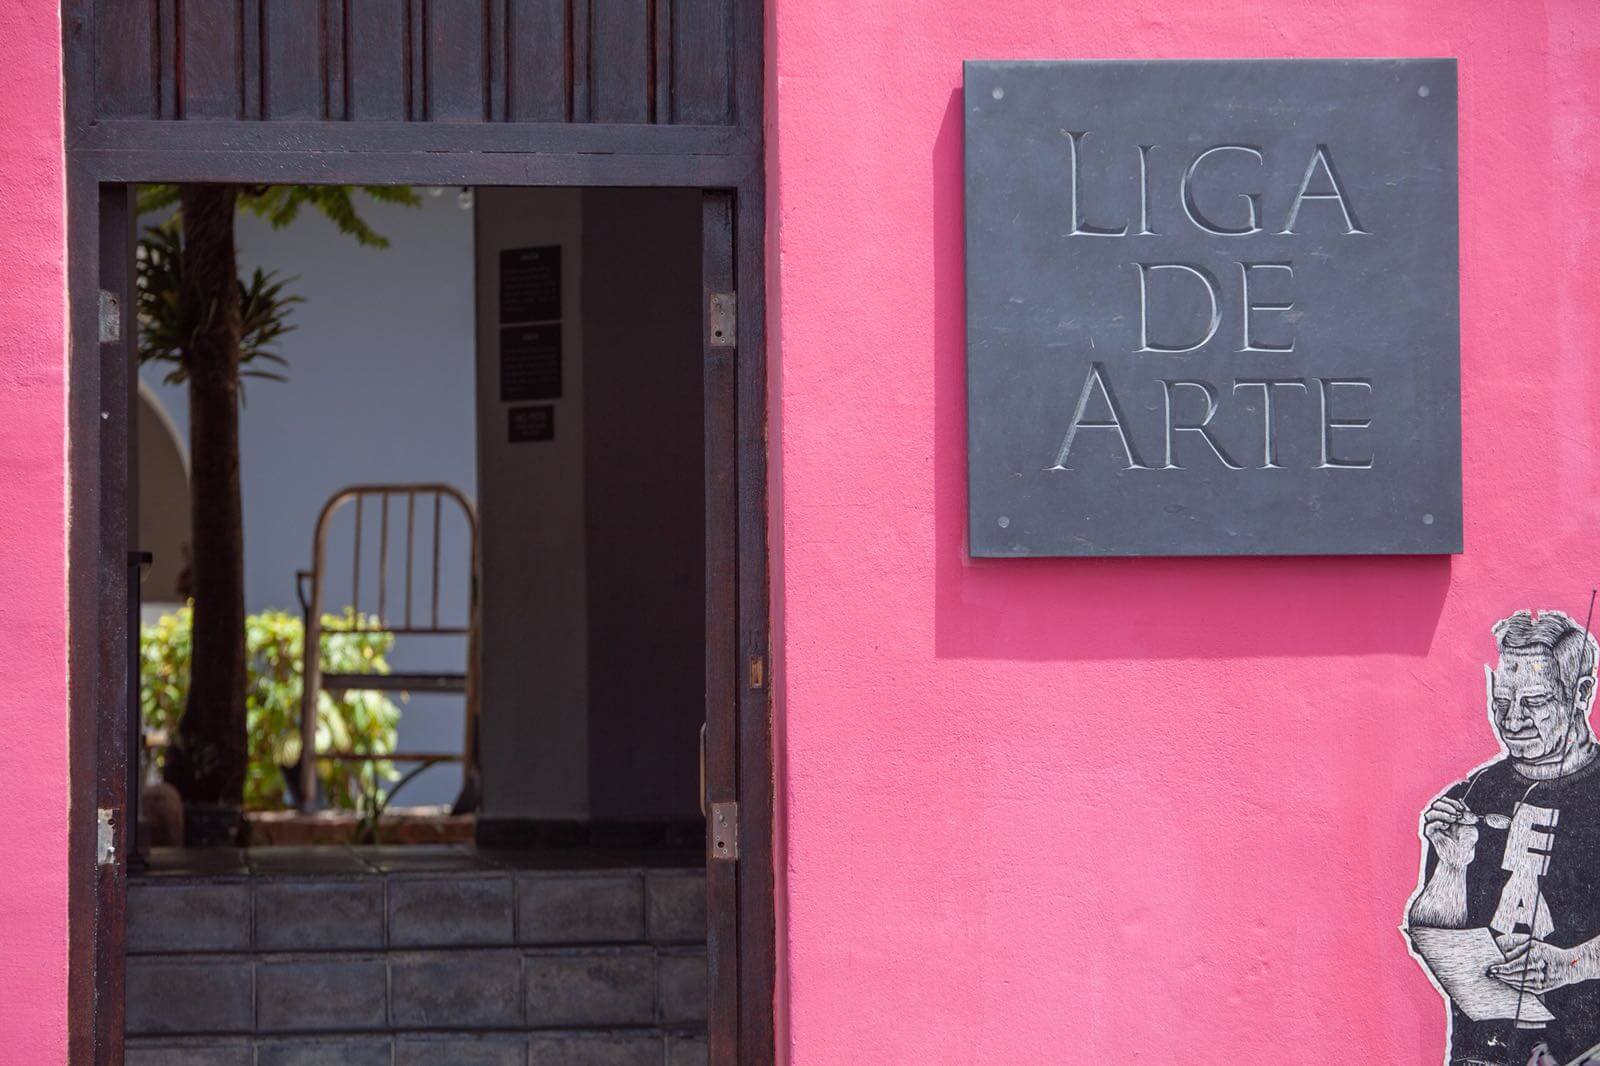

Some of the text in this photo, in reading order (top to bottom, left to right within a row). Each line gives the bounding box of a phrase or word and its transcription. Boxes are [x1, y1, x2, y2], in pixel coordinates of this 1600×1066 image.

[1061, 129, 1374, 237] LIGA
[1130, 260, 1296, 354] DE
[1045, 361, 1376, 471] ARTE
